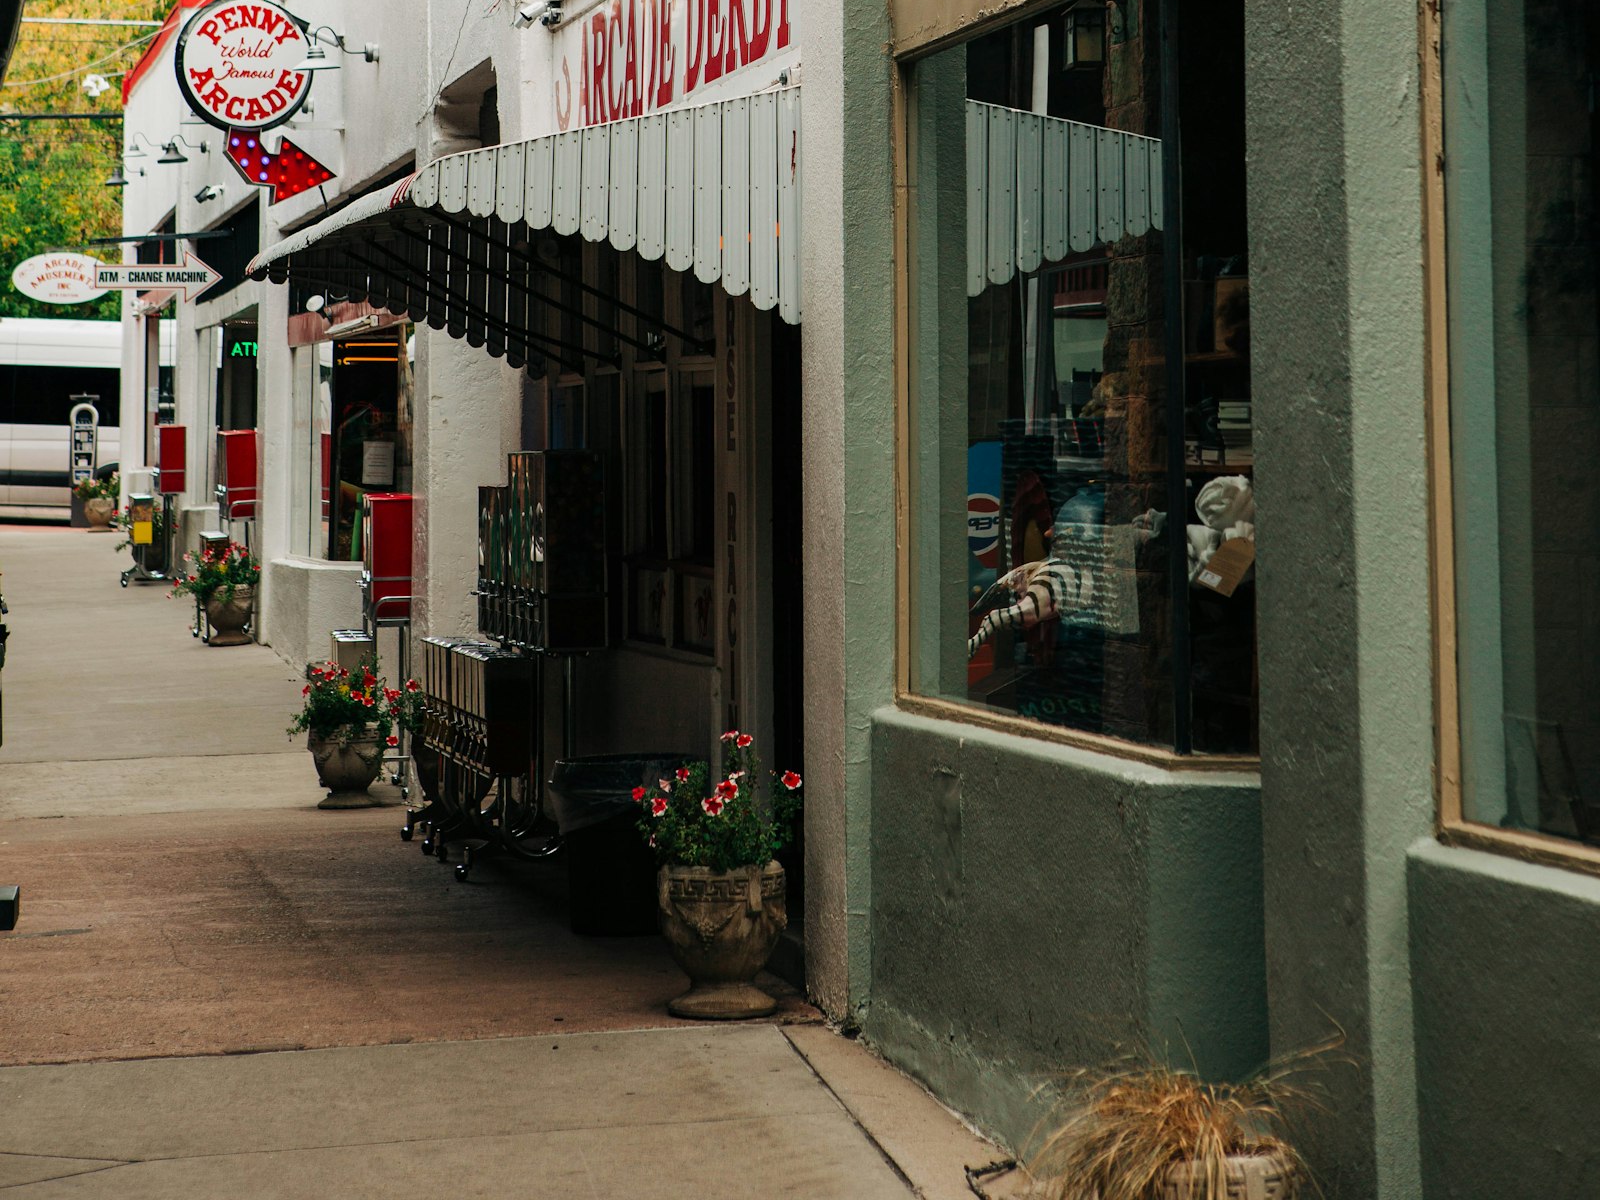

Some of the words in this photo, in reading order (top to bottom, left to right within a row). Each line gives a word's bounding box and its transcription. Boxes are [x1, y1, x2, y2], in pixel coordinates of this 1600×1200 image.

[197, 4, 300, 46] PENNY
[220, 37, 275, 58] World
[213, 60, 275, 81] Famous
[189, 66, 305, 121] ARCADE
[44, 258, 86, 271] ARCADE
[98, 271, 119, 283] ATM
[128, 271, 164, 284] CHANGE
[166, 271, 208, 284] MACHINE
[726, 297, 736, 451] RSE
[727, 491, 738, 731] RACIN
